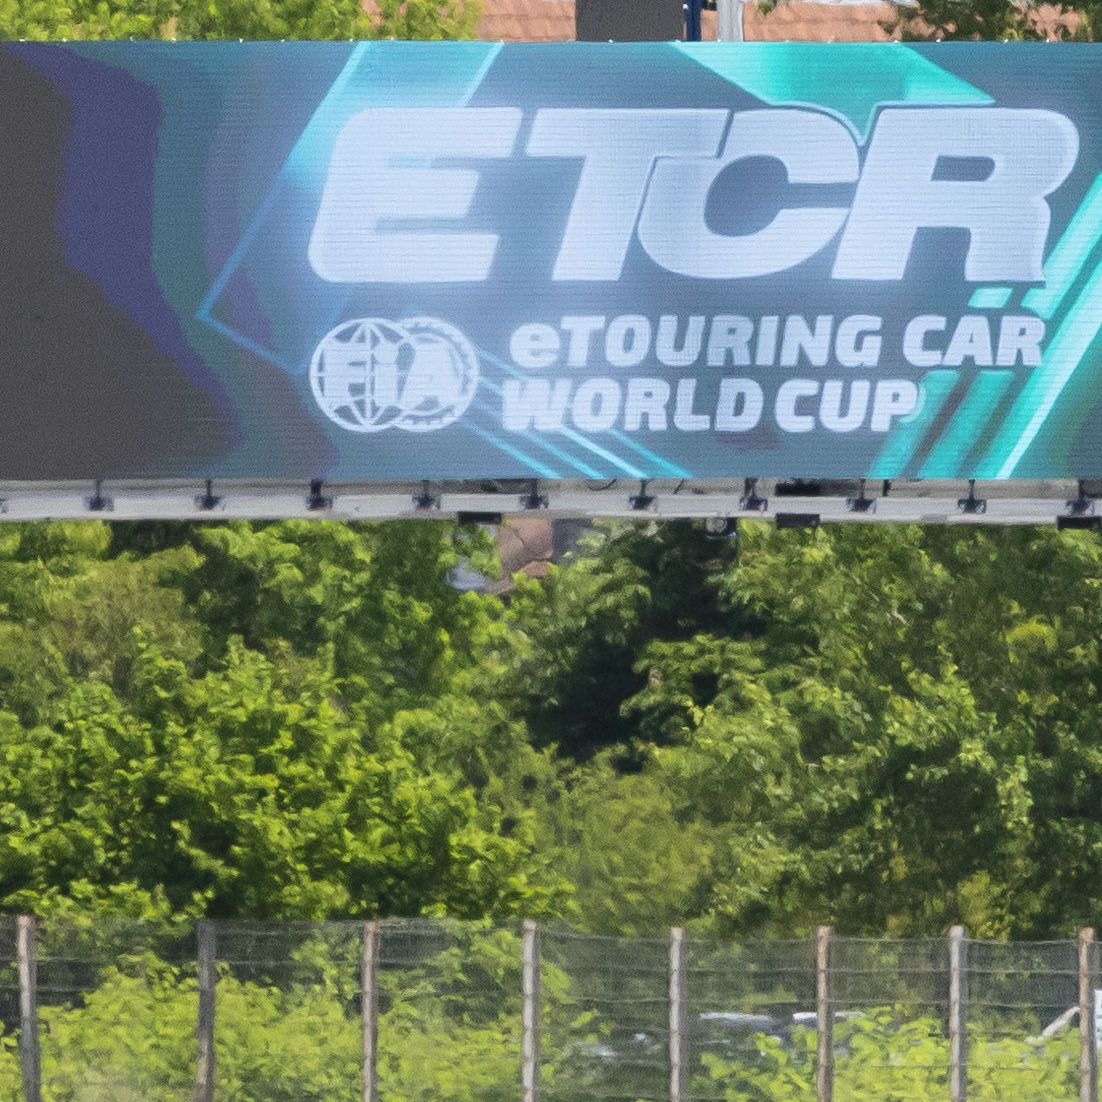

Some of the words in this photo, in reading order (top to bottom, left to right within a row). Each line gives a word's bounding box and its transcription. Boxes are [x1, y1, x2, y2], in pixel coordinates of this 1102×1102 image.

[308, 106, 1080, 282] ETCR
[509, 314, 882, 368] eTOURING
[902, 314, 1045, 368] CAR
[320, 336, 468, 414] FIA
[502, 377, 764, 433] WORLD
[774, 378, 918, 433] CUP
